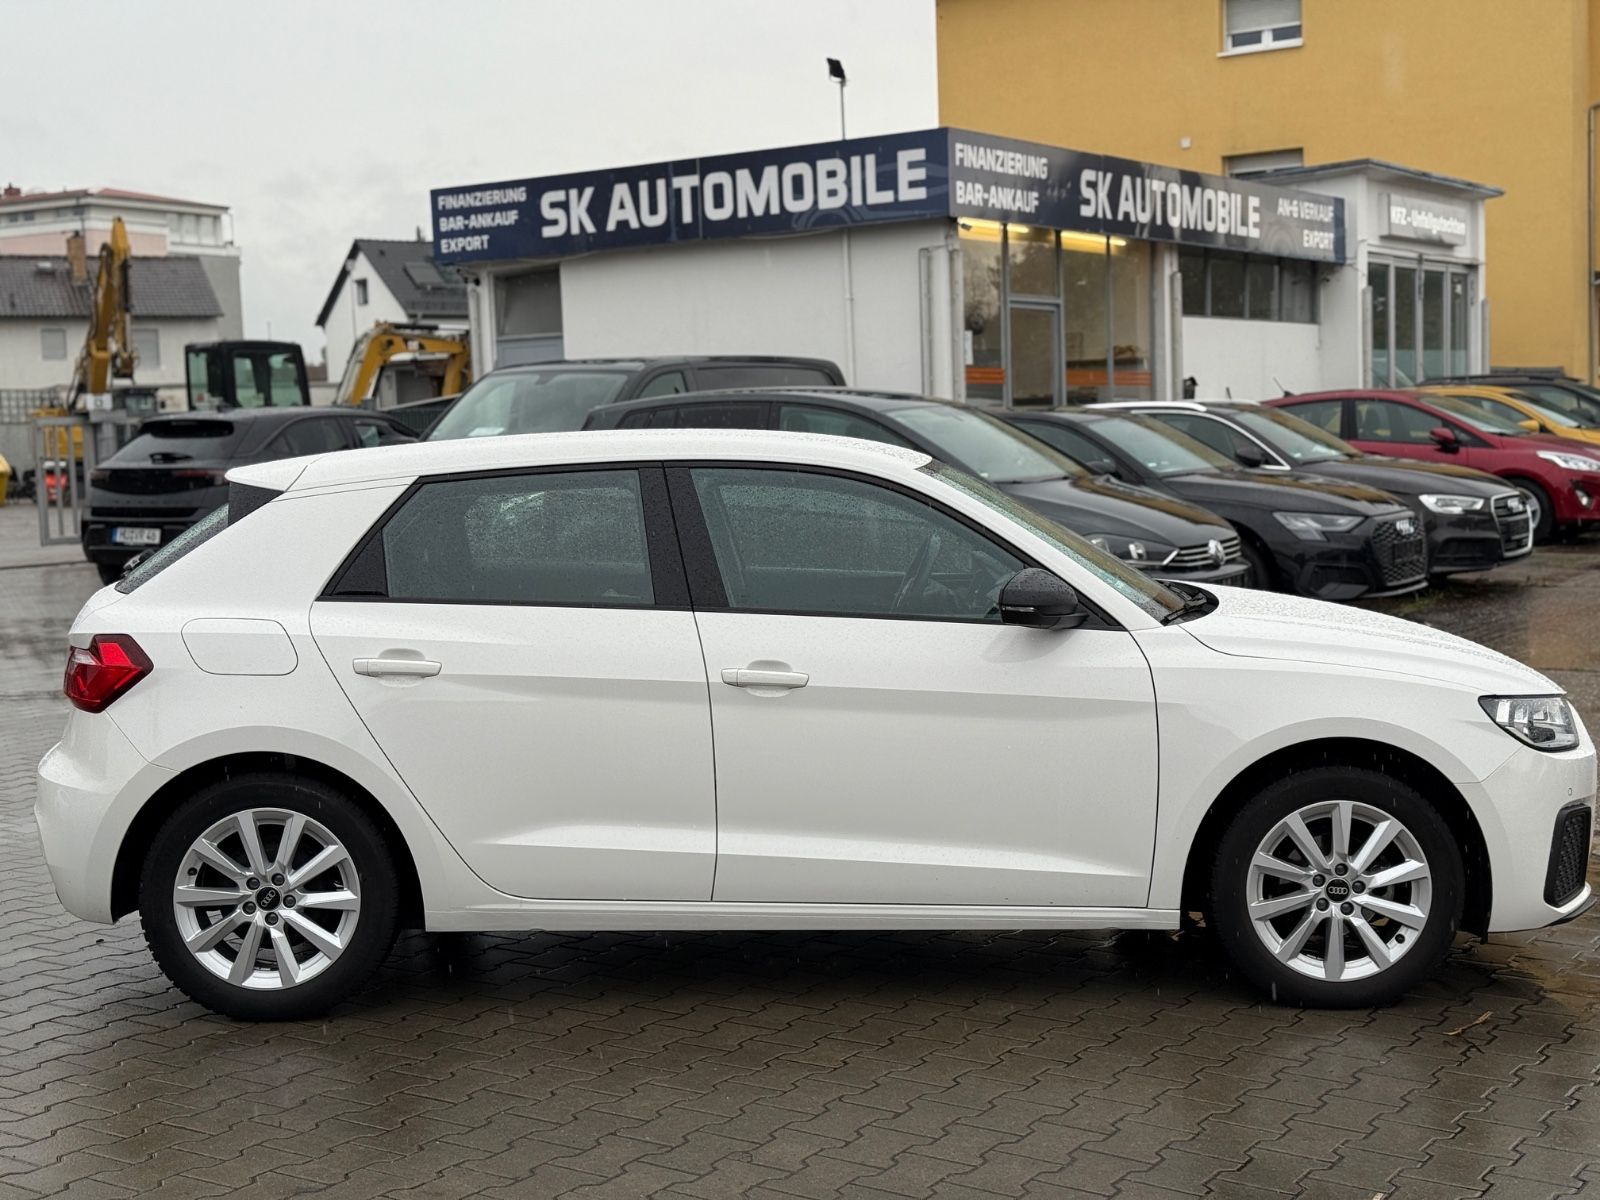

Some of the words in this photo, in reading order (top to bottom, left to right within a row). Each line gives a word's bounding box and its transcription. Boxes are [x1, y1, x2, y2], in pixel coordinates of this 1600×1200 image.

[954, 142, 1048, 180] FINANZIERUNG
[437, 186, 527, 211] FINANZIERUNG
[541, 186, 596, 238] SK
[606, 148, 927, 232] AUTOMOBILE
[955, 180, 1039, 214] BAR-ANKAUF
[1079, 168, 1114, 220] SK
[1117, 174, 1260, 239] AUTOMOBILE
[439, 209, 519, 233] BAR-ANKAUF
[1299, 200, 1334, 222] VERKAUF
[440, 234, 490, 254] EXPORT
[1303, 229, 1334, 250] EXPORT
